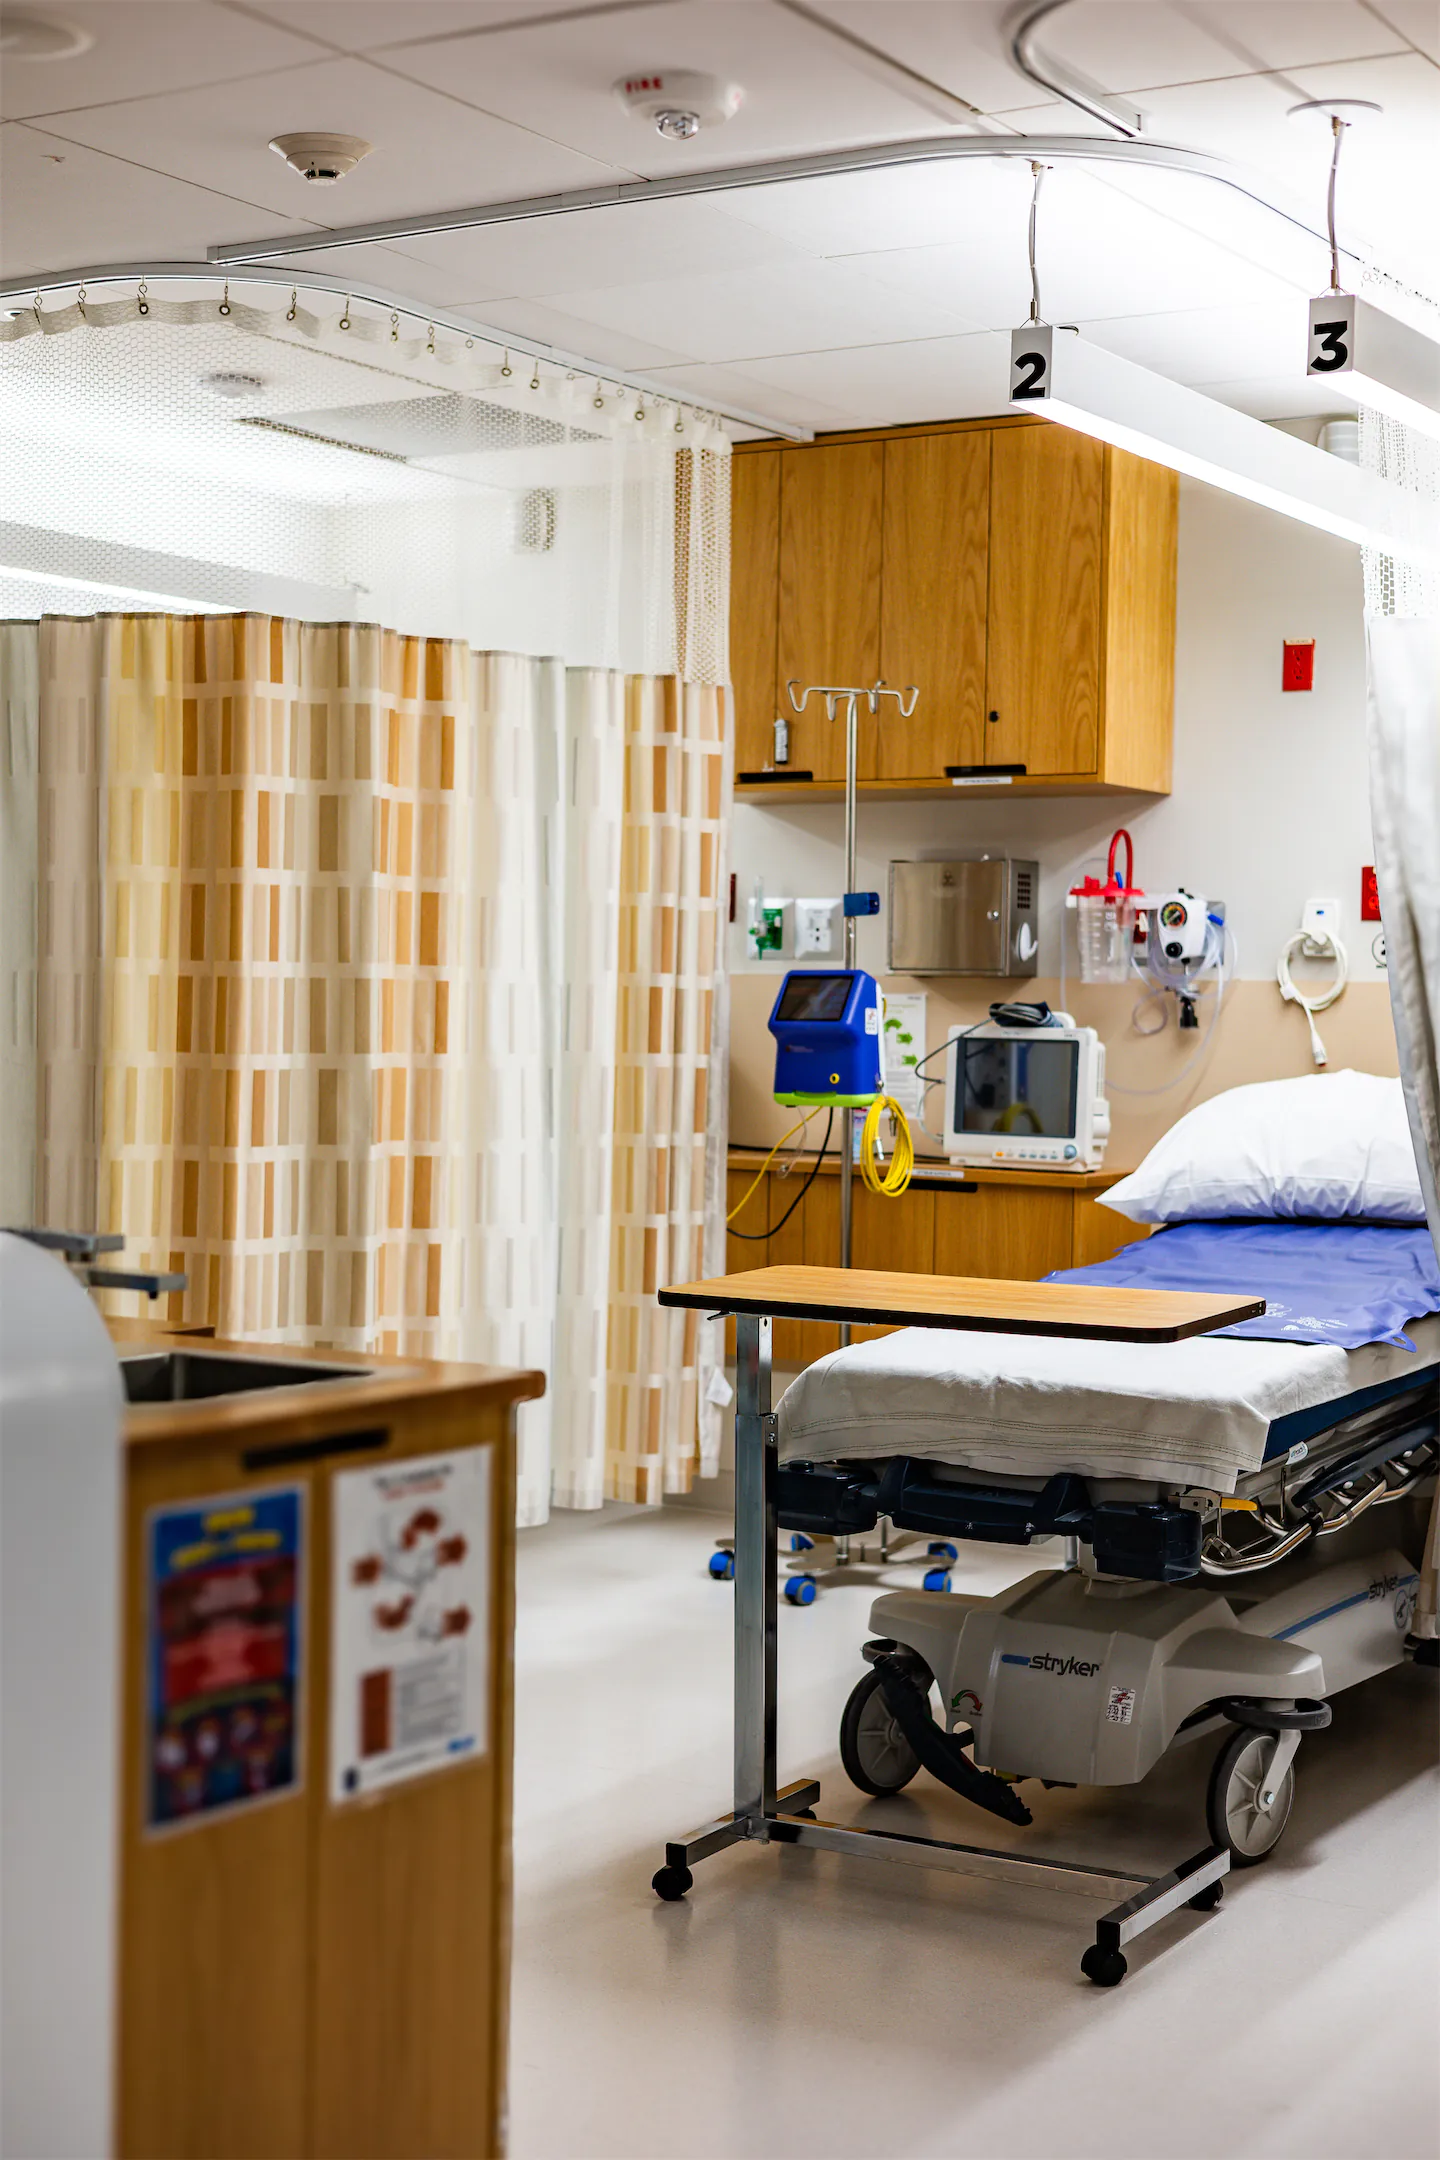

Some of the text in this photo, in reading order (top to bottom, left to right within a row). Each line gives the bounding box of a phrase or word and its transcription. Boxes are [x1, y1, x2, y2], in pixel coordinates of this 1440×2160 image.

[625, 76, 663, 93] FIRE
[1310, 320, 1348, 372] 3
[1012, 352, 1047, 399] 2
[1028, 1652, 1100, 1677] stryker
